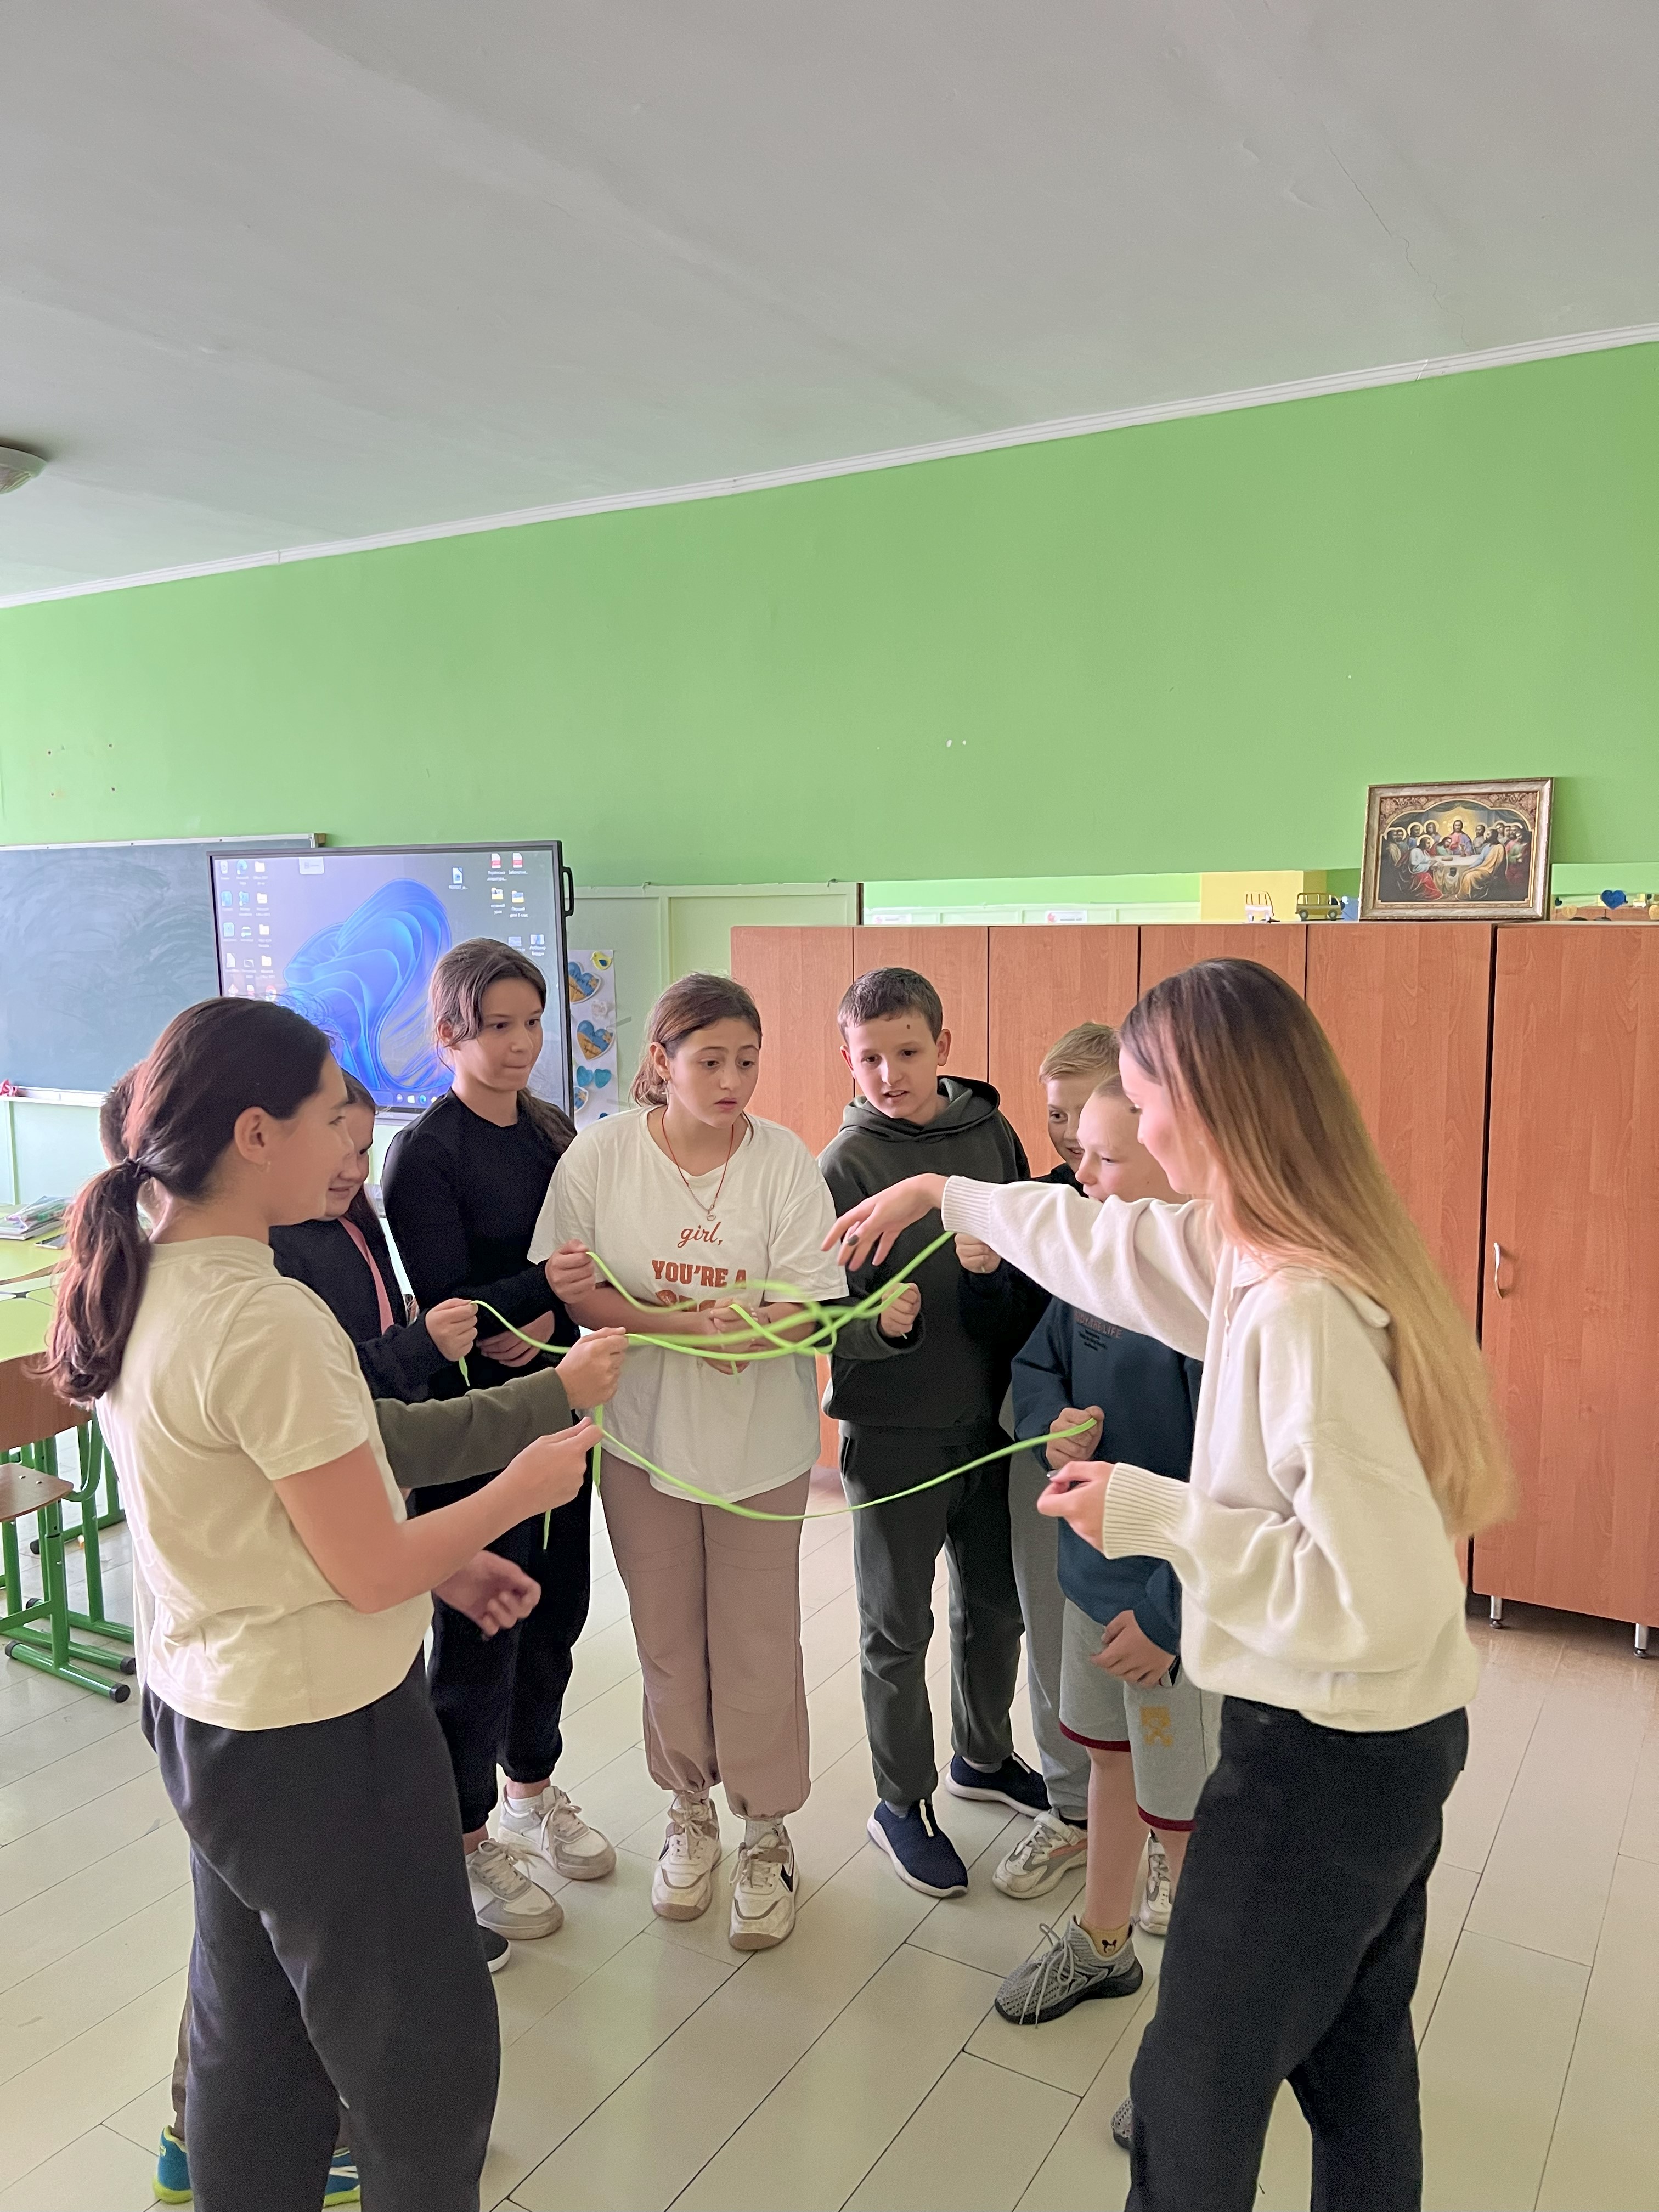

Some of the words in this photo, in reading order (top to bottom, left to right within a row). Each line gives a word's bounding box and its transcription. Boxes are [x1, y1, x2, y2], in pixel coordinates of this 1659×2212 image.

[677, 1222, 723, 1248] girl,
[652, 1260, 729, 1288] YOU'RE
[735, 1269, 747, 1290] A
[1103, 1324, 1122, 1339] LIFE
